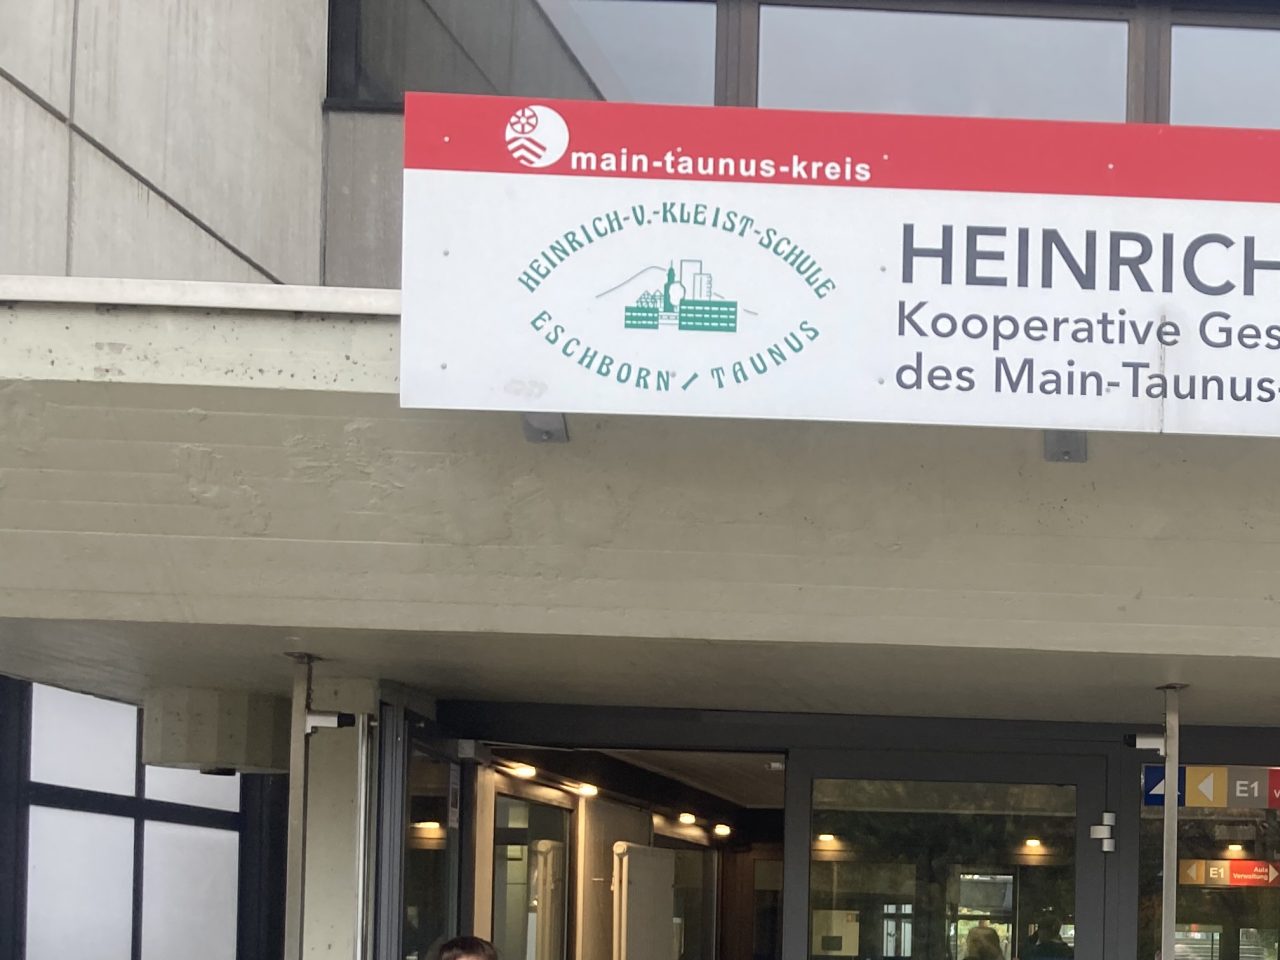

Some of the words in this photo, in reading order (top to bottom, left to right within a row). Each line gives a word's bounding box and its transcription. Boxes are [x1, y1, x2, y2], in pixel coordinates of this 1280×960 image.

[570, 149, 872, 182] main-taunus-kreis
[898, 300, 1182, 351] Kooperative
[895, 351, 976, 392] des
[1236, 781, 1259, 797] E1
[1209, 867, 1225, 879] E1
